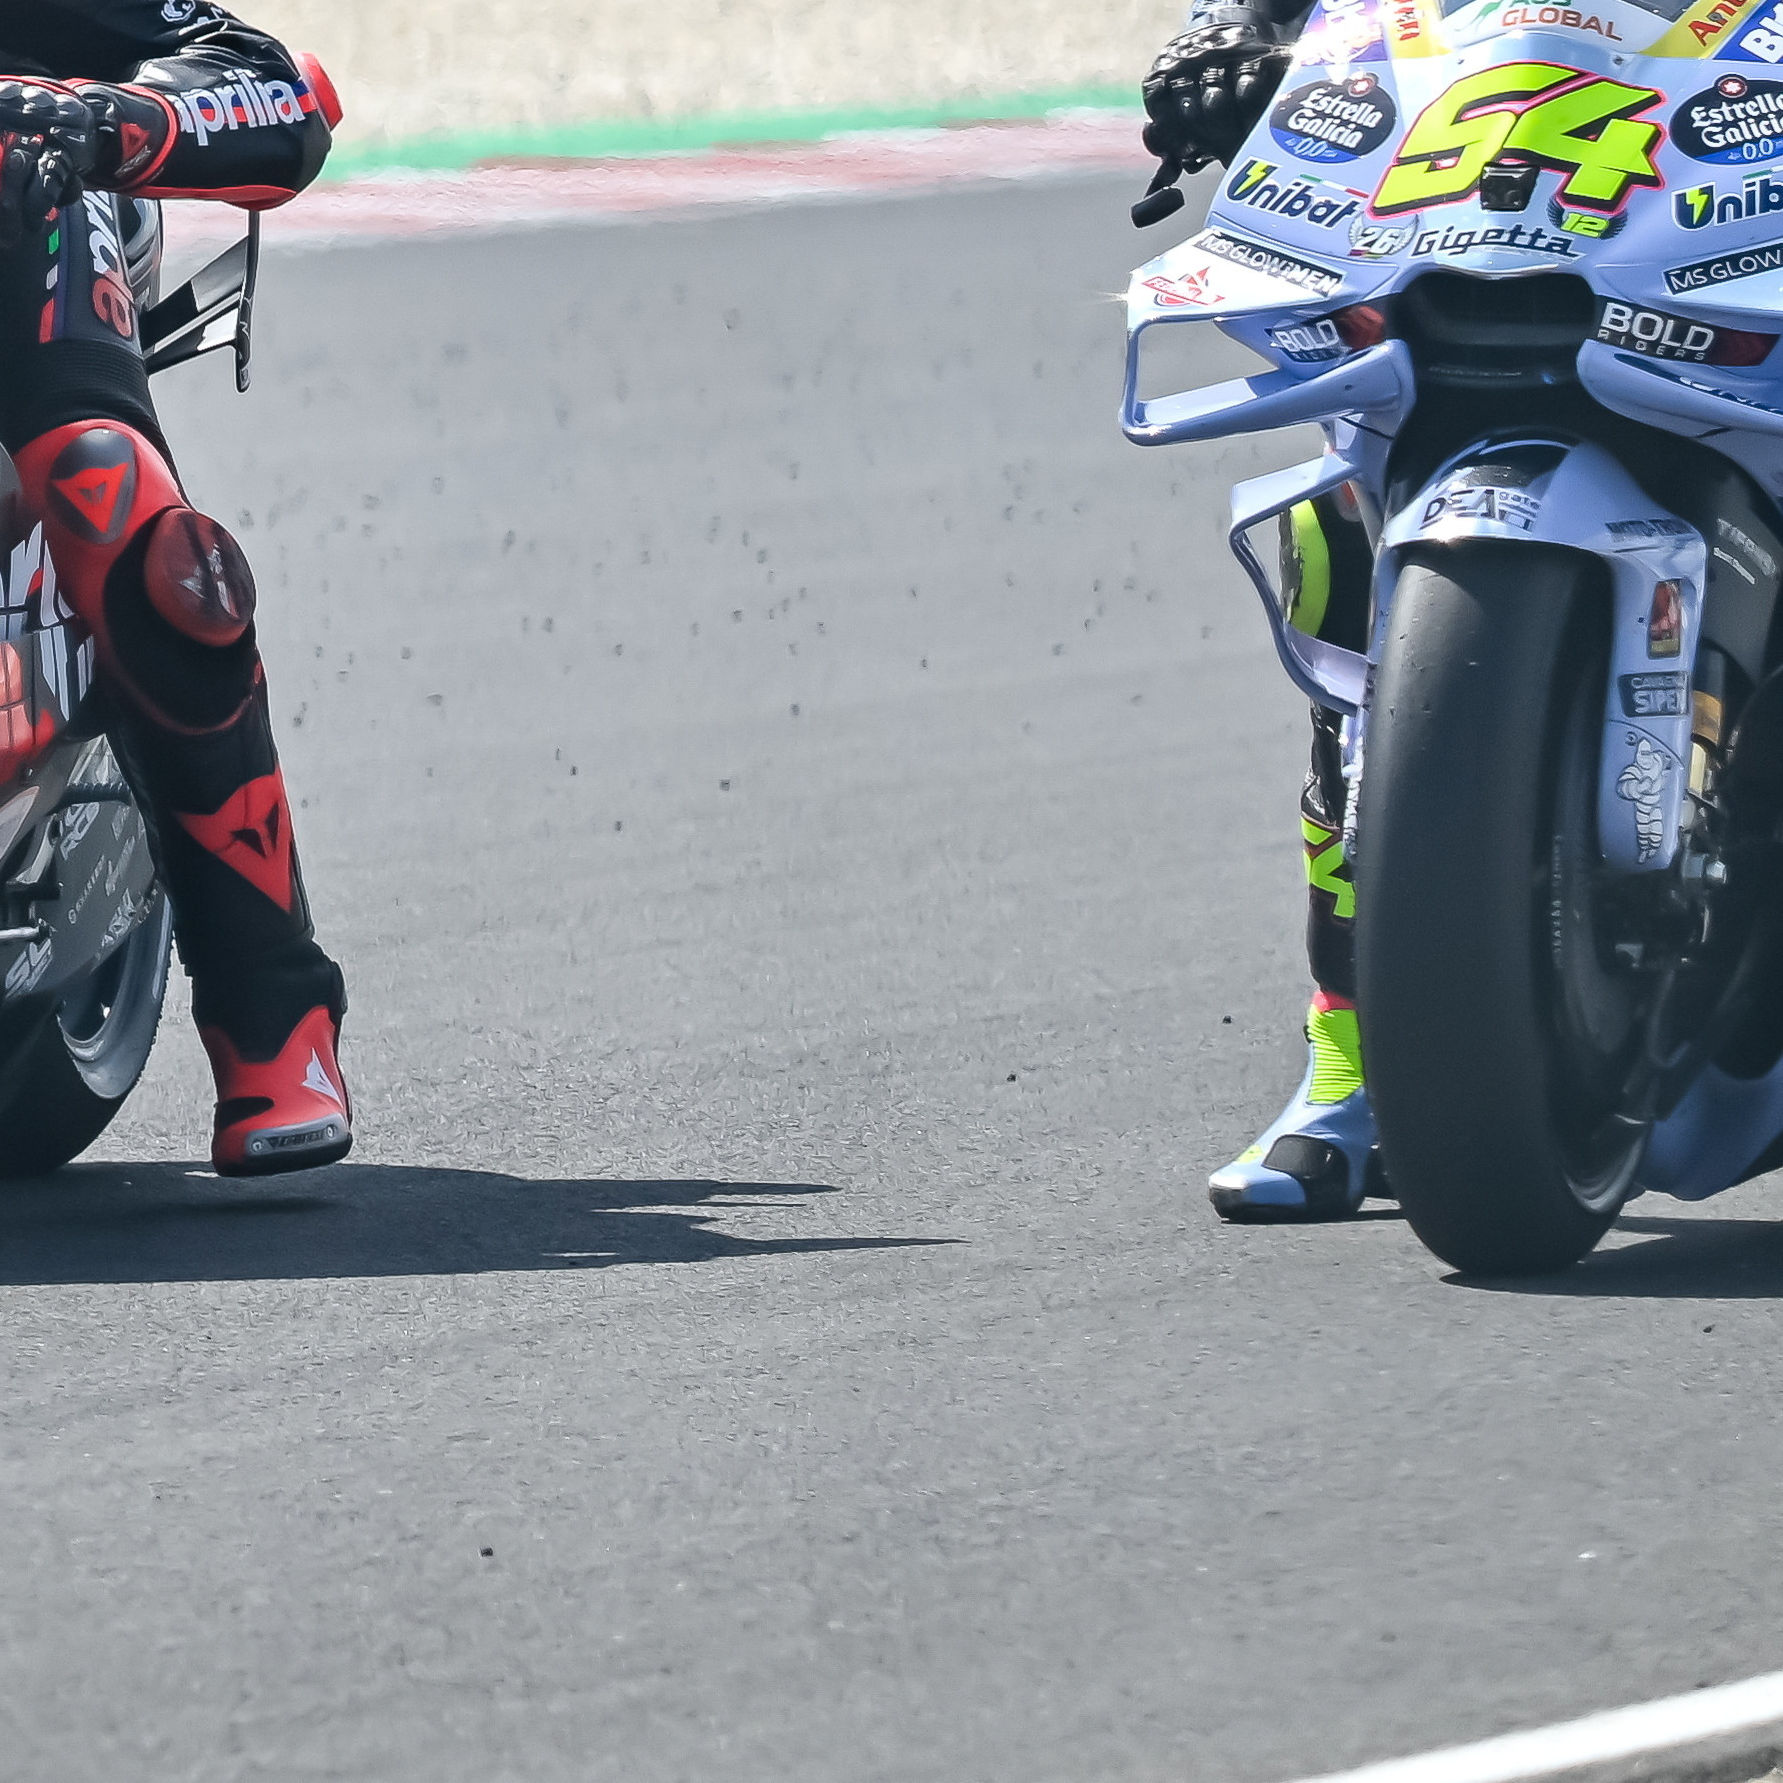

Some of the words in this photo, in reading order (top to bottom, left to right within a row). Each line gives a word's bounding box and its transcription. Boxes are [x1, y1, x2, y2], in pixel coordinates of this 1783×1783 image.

[1500, 6, 1623, 42] GLOBAL
[176, 69, 306, 146] aprilia
[1300, 88, 1383, 129] Estrella
[1287, 108, 1364, 148] Galicia
[1371, 61, 1660, 213] 54
[1227, 159, 1360, 228] Unibat
[1354, 225, 1399, 256] 26
[1411, 223, 1581, 258] Gigetta
[1560, 211, 1610, 238] 12
[1668, 267, 1708, 291] MS
[1274, 318, 1340, 352] BOLD
[1597, 328, 1706, 361] RIDERS
[1600, 302, 1715, 352] BOLD
